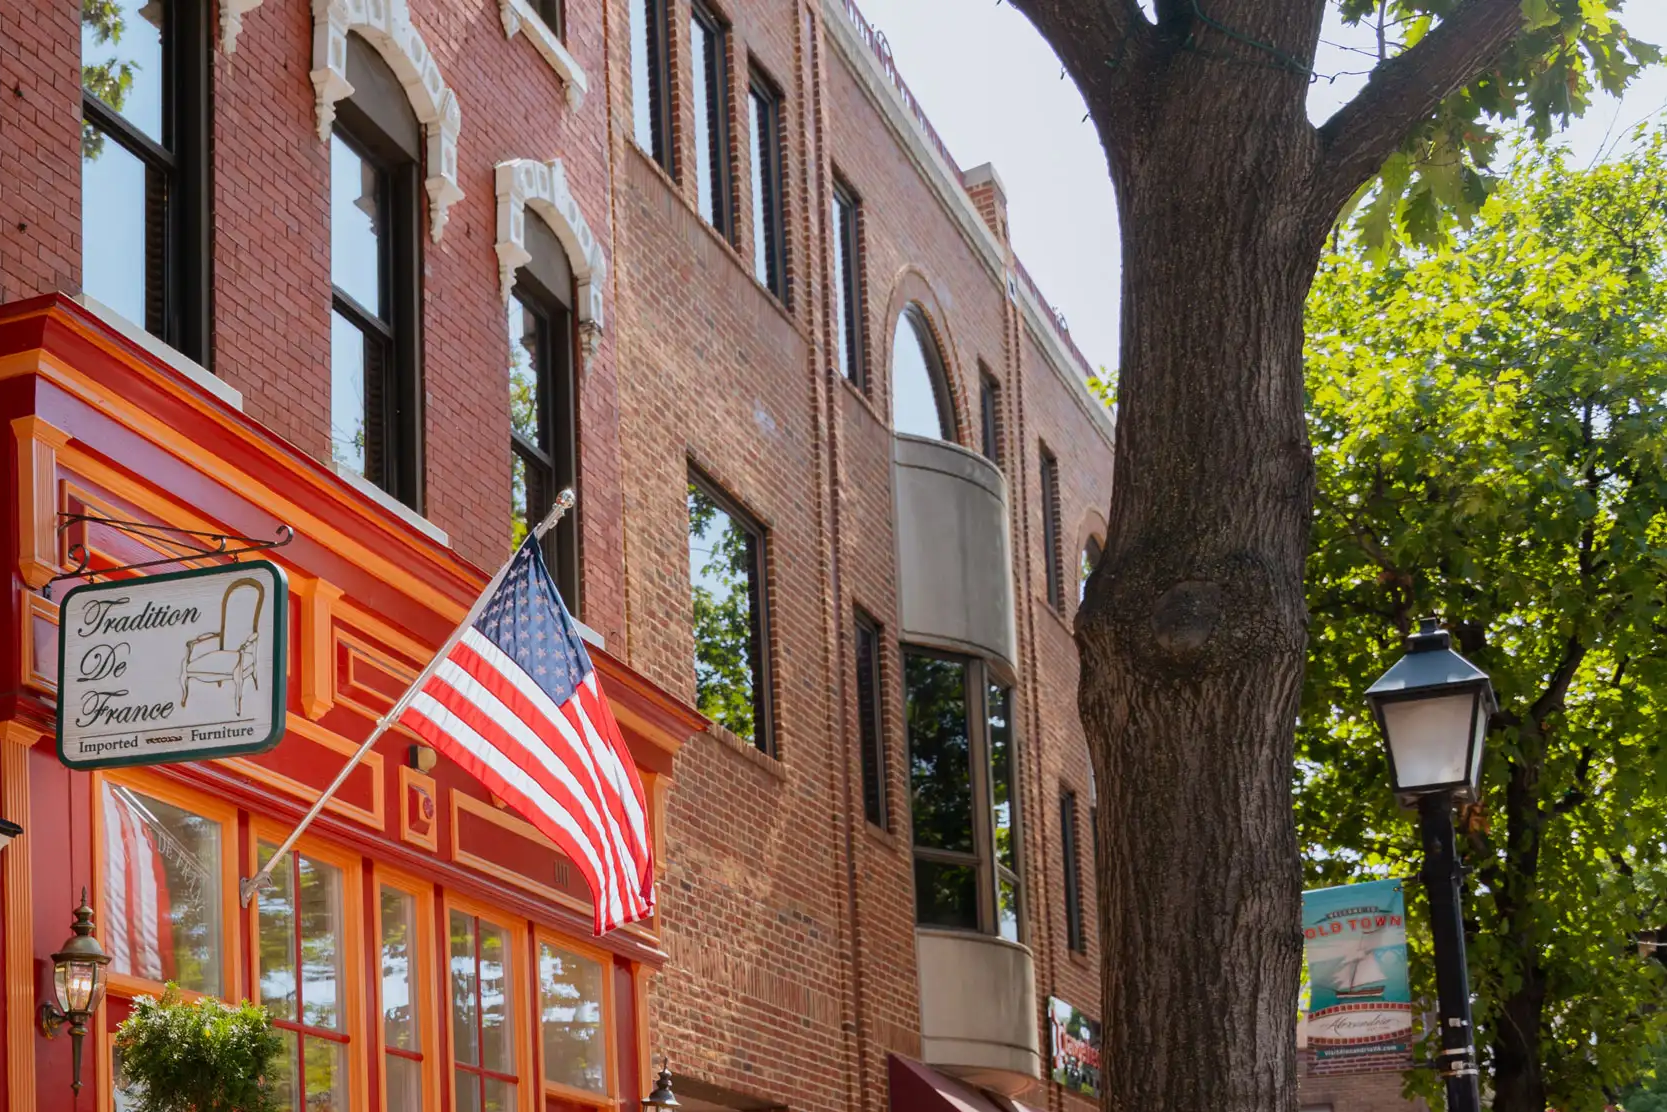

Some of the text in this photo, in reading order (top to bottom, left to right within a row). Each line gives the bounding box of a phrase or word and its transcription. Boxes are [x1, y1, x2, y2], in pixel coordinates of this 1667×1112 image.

[78, 597, 202, 638] Tradition
[76, 642, 131, 683] De
[76, 689, 175, 728] France
[79, 725, 255, 756] Imported Furniture
[1304, 914, 1403, 940] OLD TOWN
